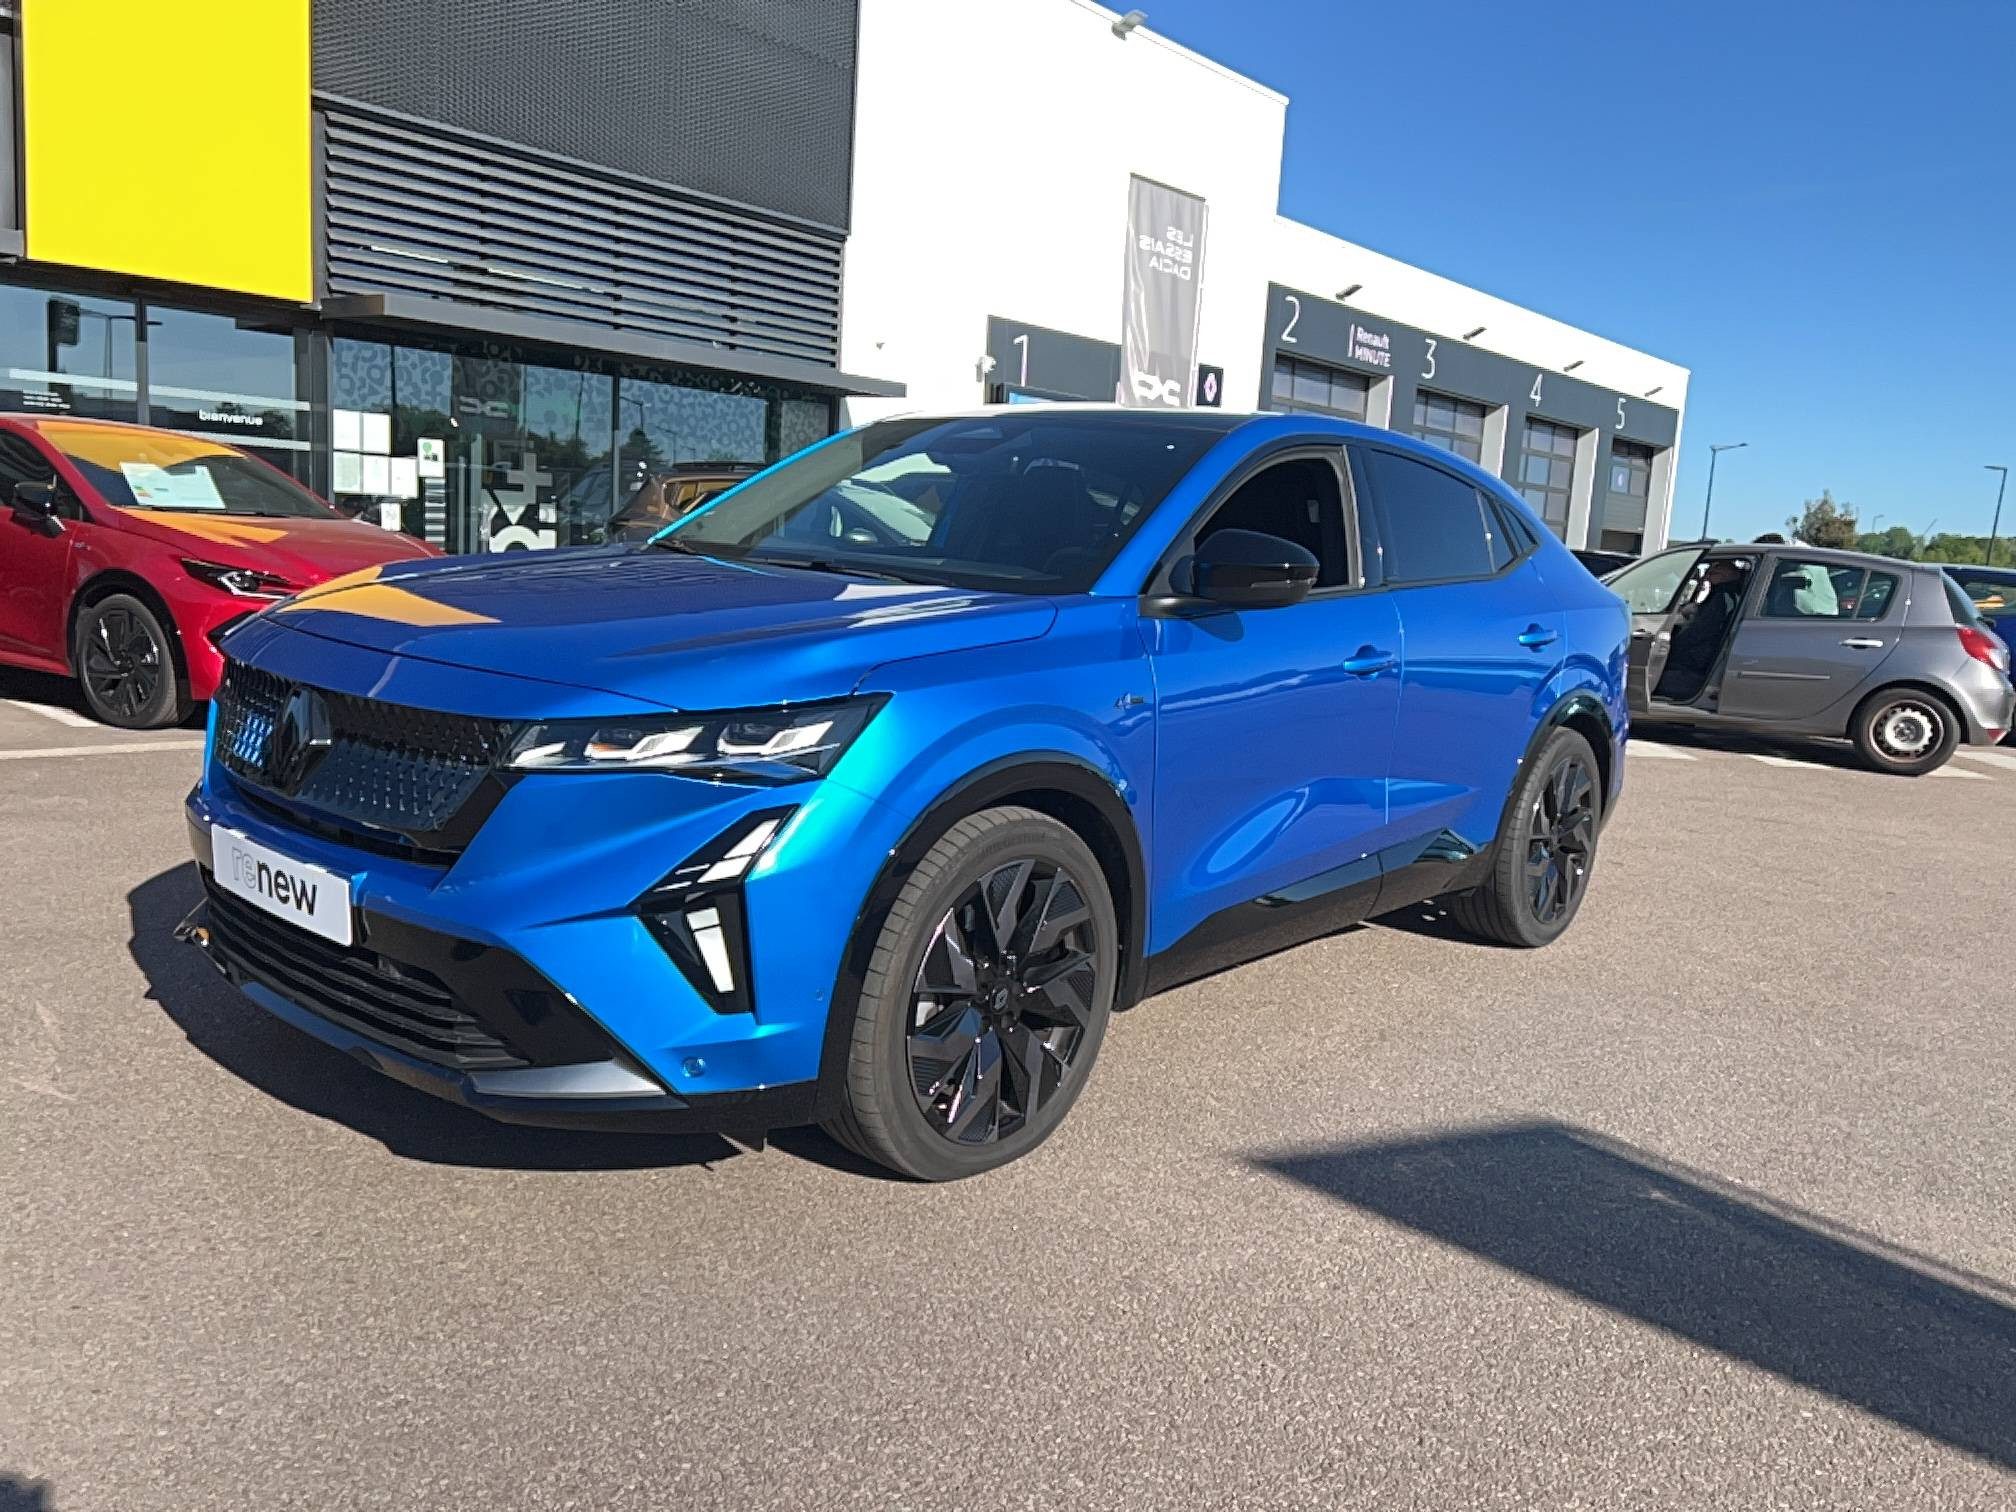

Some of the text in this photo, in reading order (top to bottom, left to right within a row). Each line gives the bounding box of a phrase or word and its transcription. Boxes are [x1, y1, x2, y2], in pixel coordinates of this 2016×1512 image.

[1281, 295, 1300, 343] 2
[1356, 326, 1390, 350] Renault
[1013, 334, 1028, 388] 1
[1354, 344, 1391, 368] MINUTE
[1421, 338, 1438, 380] 3
[1529, 374, 1543, 407] 4
[199, 408, 264, 427] bienvenue
[1615, 397, 1627, 430] 5
[232, 847, 317, 916] renew
